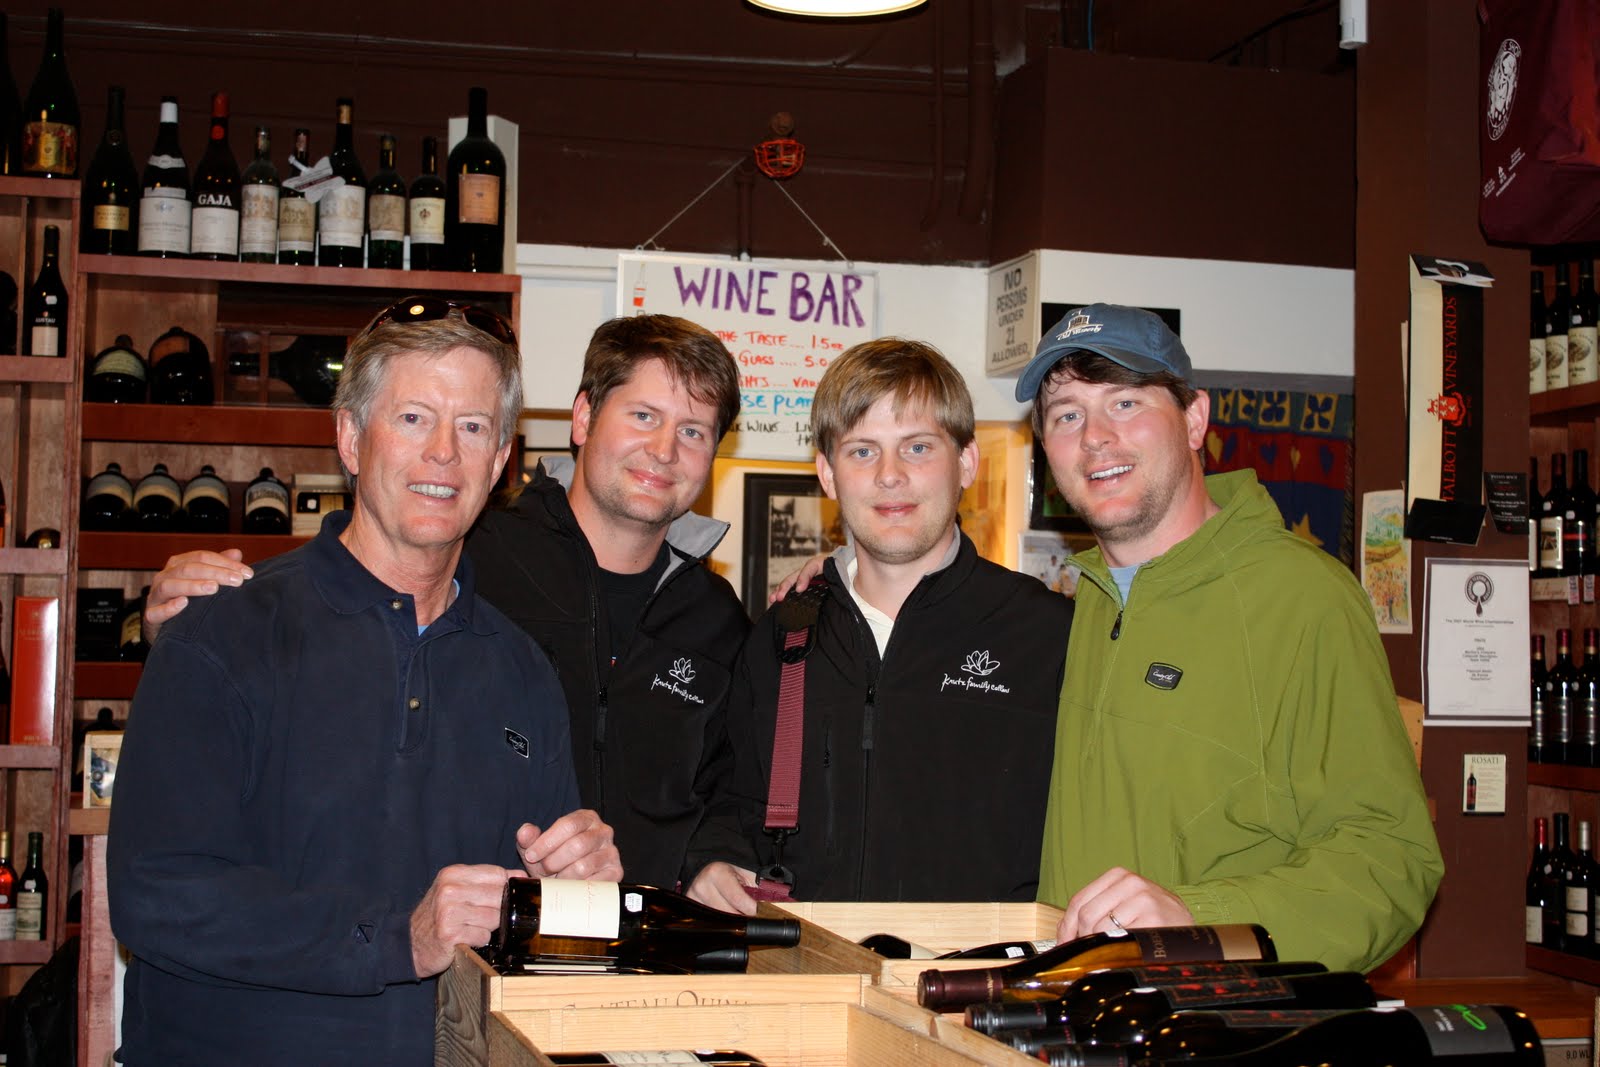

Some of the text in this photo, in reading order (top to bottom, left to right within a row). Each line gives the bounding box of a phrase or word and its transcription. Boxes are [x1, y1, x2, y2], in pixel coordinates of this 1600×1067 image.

[198, 194, 232, 206] GAJA
[1004, 268, 1022, 292] NO
[673, 266, 866, 328] WINE BAR
[996, 286, 1028, 314] PERSONS
[998, 308, 1024, 327] UNDER
[744, 331, 787, 346] TASTE
[1006, 325, 1015, 346] 21
[1443, 296, 1457, 500] TALBOTT VINEYARDS
[966, 677, 990, 693] family
[1471, 756, 1499, 764] ROSATI
